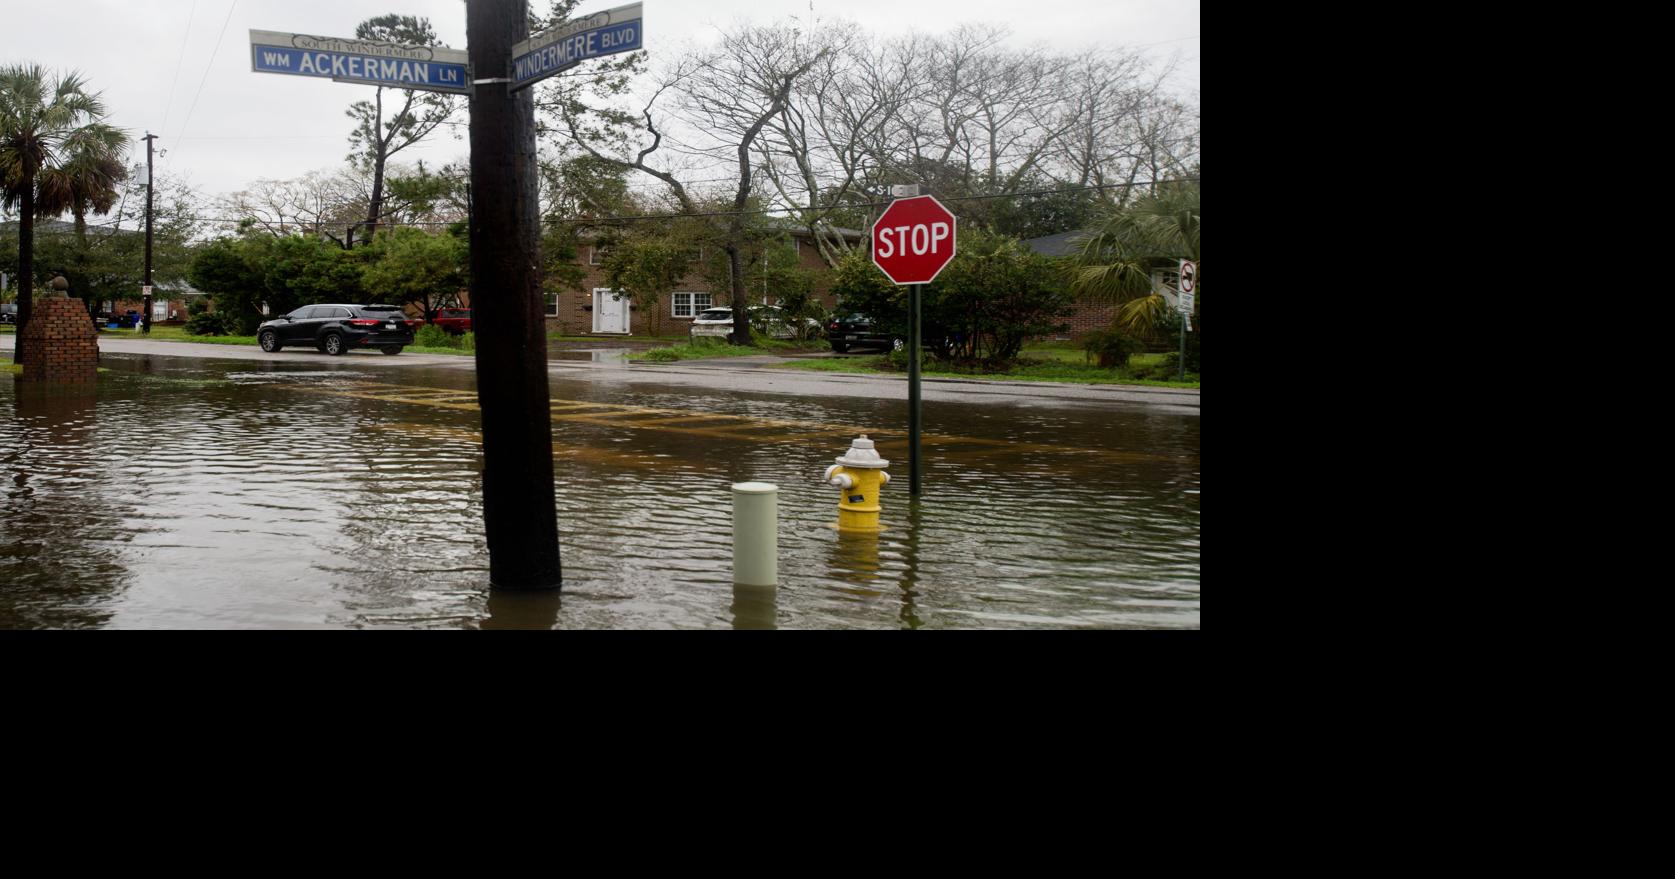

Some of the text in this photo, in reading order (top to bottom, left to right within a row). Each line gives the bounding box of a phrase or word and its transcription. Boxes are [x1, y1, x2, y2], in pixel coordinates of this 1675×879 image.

[302, 40, 424, 59] SOUTH WINDERMERE
[515, 32, 597, 80] WINDERMERE
[602, 28, 634, 48] BLVD
[263, 52, 457, 83] WM ACKERMAN LN
[878, 222, 949, 258] STOP
